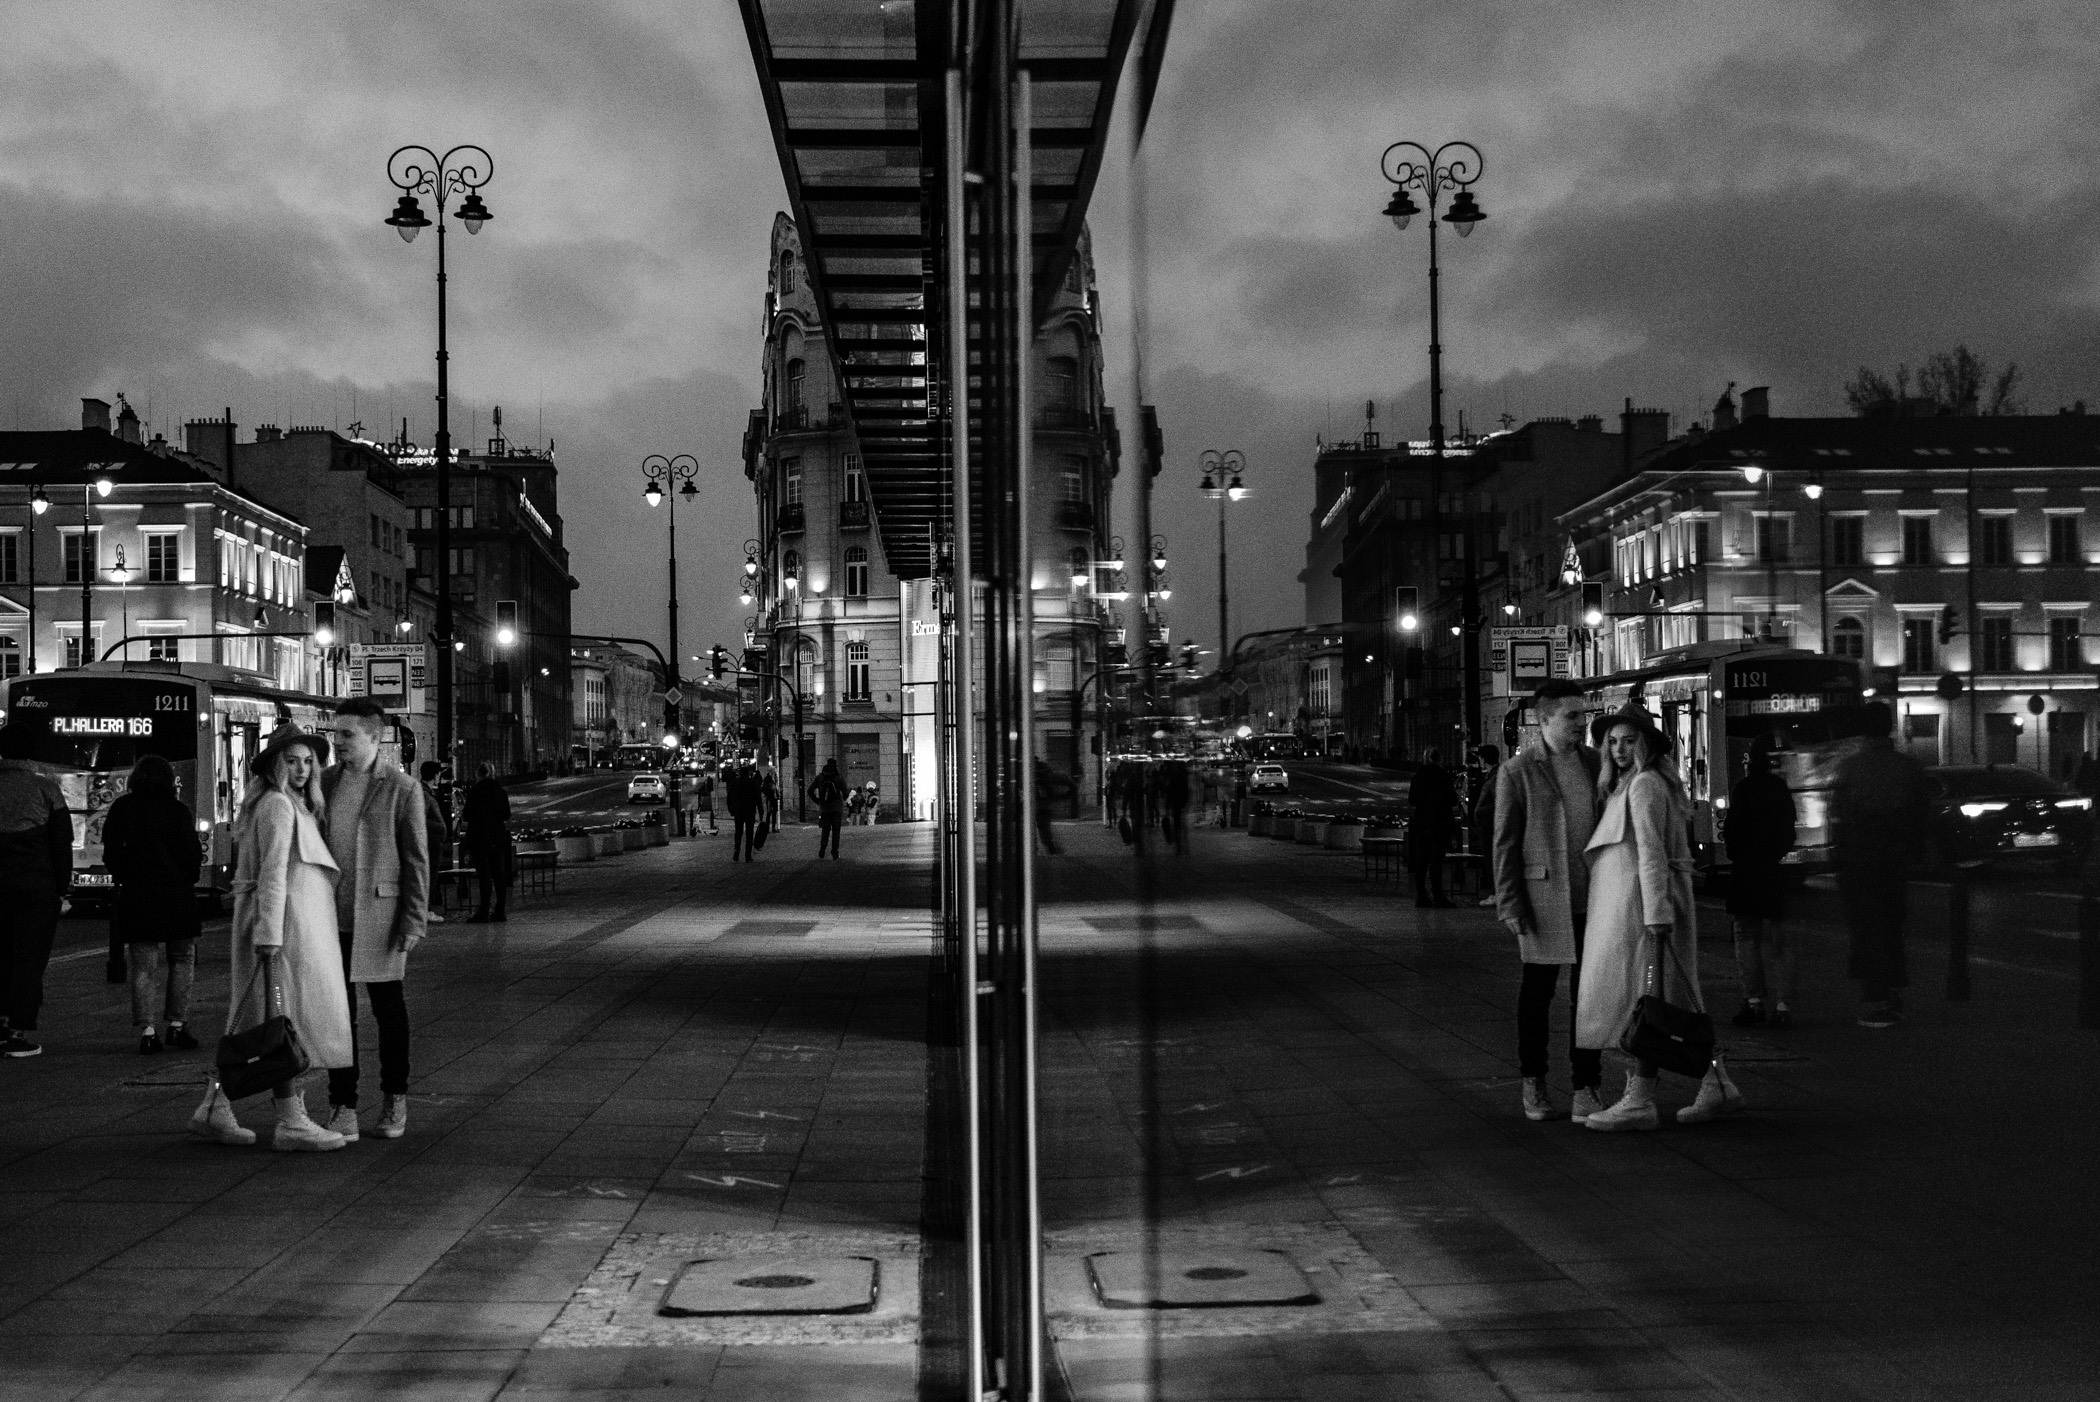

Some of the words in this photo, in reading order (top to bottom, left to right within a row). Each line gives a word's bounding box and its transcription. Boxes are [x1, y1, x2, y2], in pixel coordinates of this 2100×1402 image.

[154, 695, 189, 712] 1211
[54, 717, 124, 733] PL.HALLERA
[127, 718, 152, 736] 166
